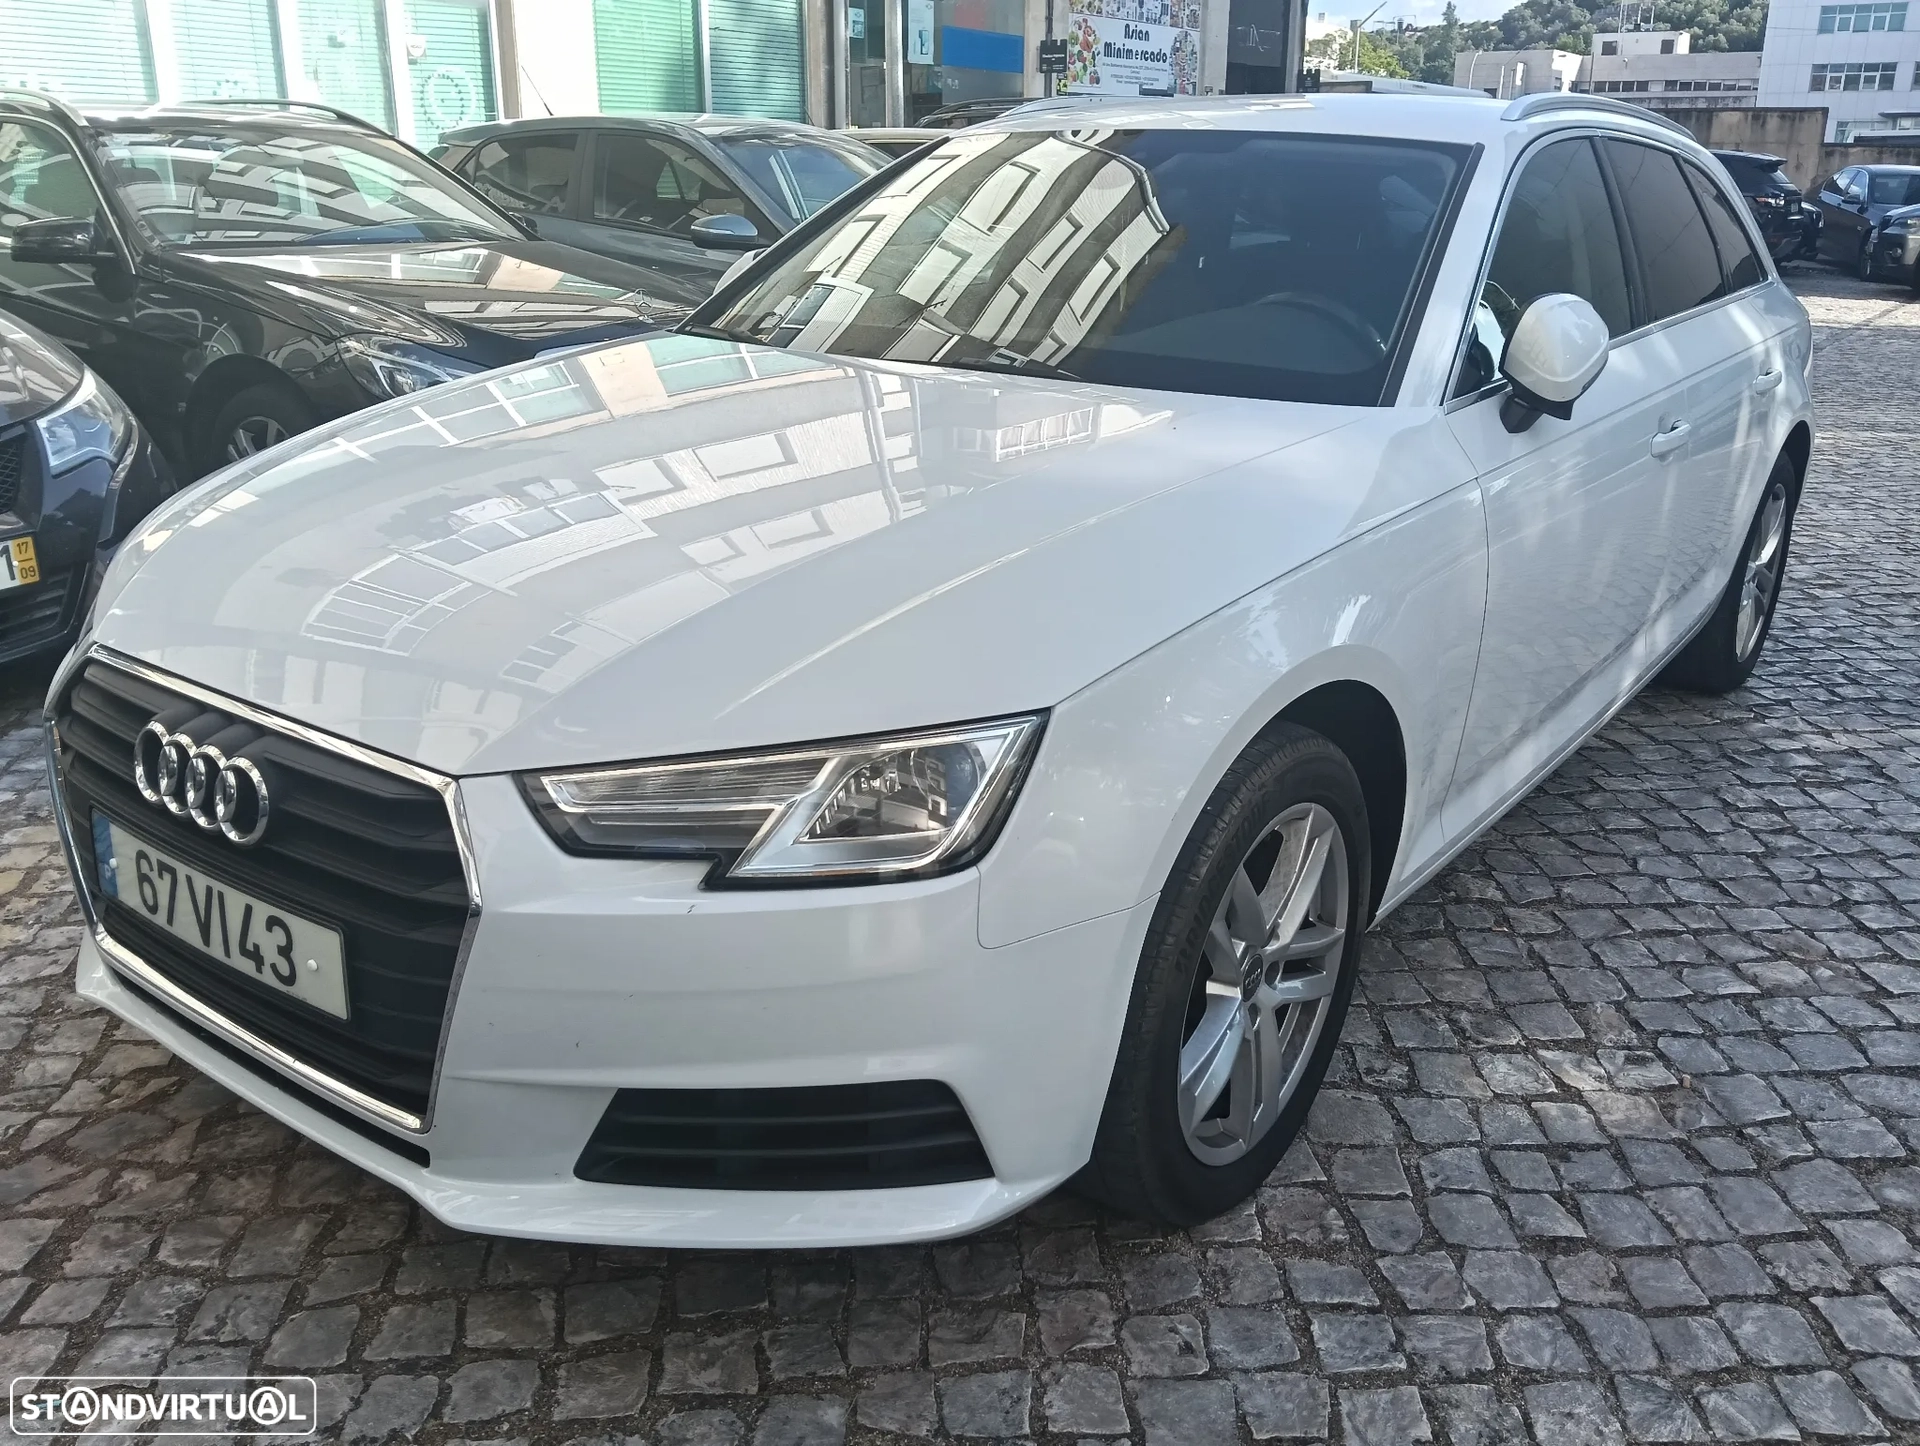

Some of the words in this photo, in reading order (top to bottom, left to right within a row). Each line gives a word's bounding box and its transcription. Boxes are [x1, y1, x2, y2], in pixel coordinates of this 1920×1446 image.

[1124, 23, 1150, 42] Asian
[1103, 41, 1168, 64] Minimercado
[17, 541, 28, 555] 17
[20, 566, 36, 579] 09
